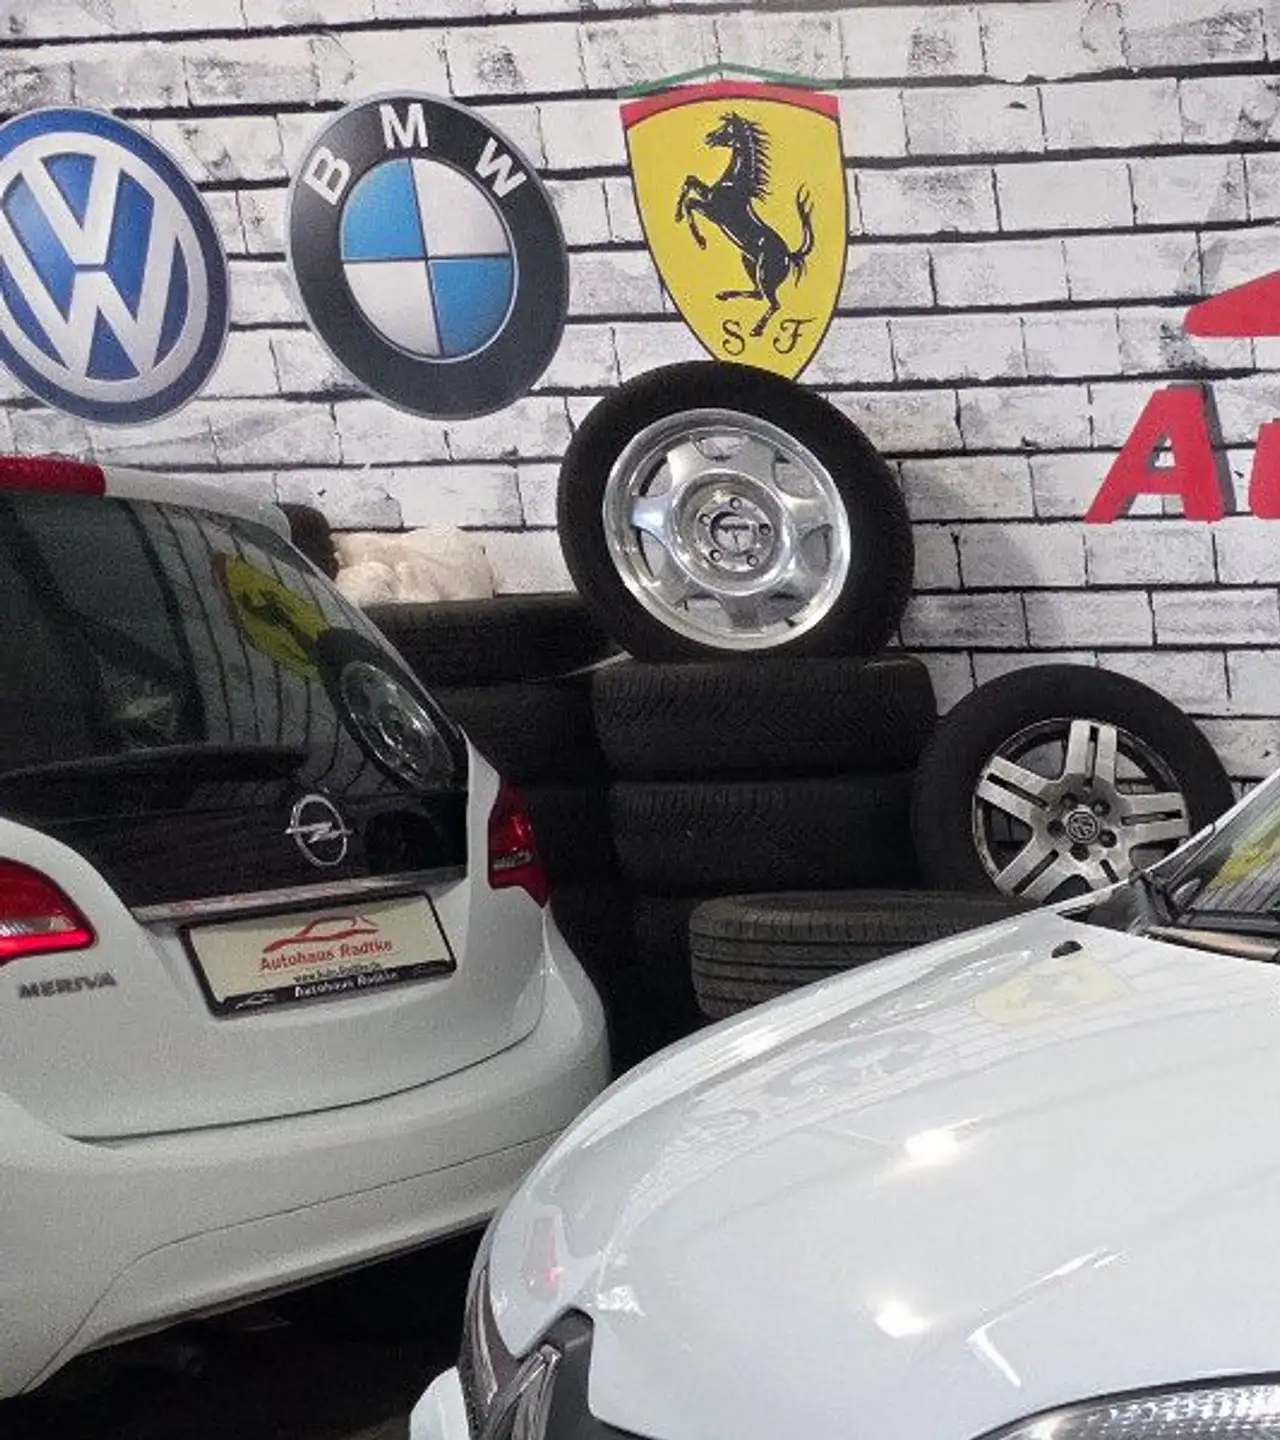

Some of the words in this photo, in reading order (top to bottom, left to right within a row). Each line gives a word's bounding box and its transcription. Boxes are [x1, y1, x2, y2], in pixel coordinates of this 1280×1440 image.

[303, 103, 527, 206] BMW
[259, 951, 336, 972] Autohaus
[339, 939, 393, 958] Radtke
[18, 972, 117, 999] MERIVA
